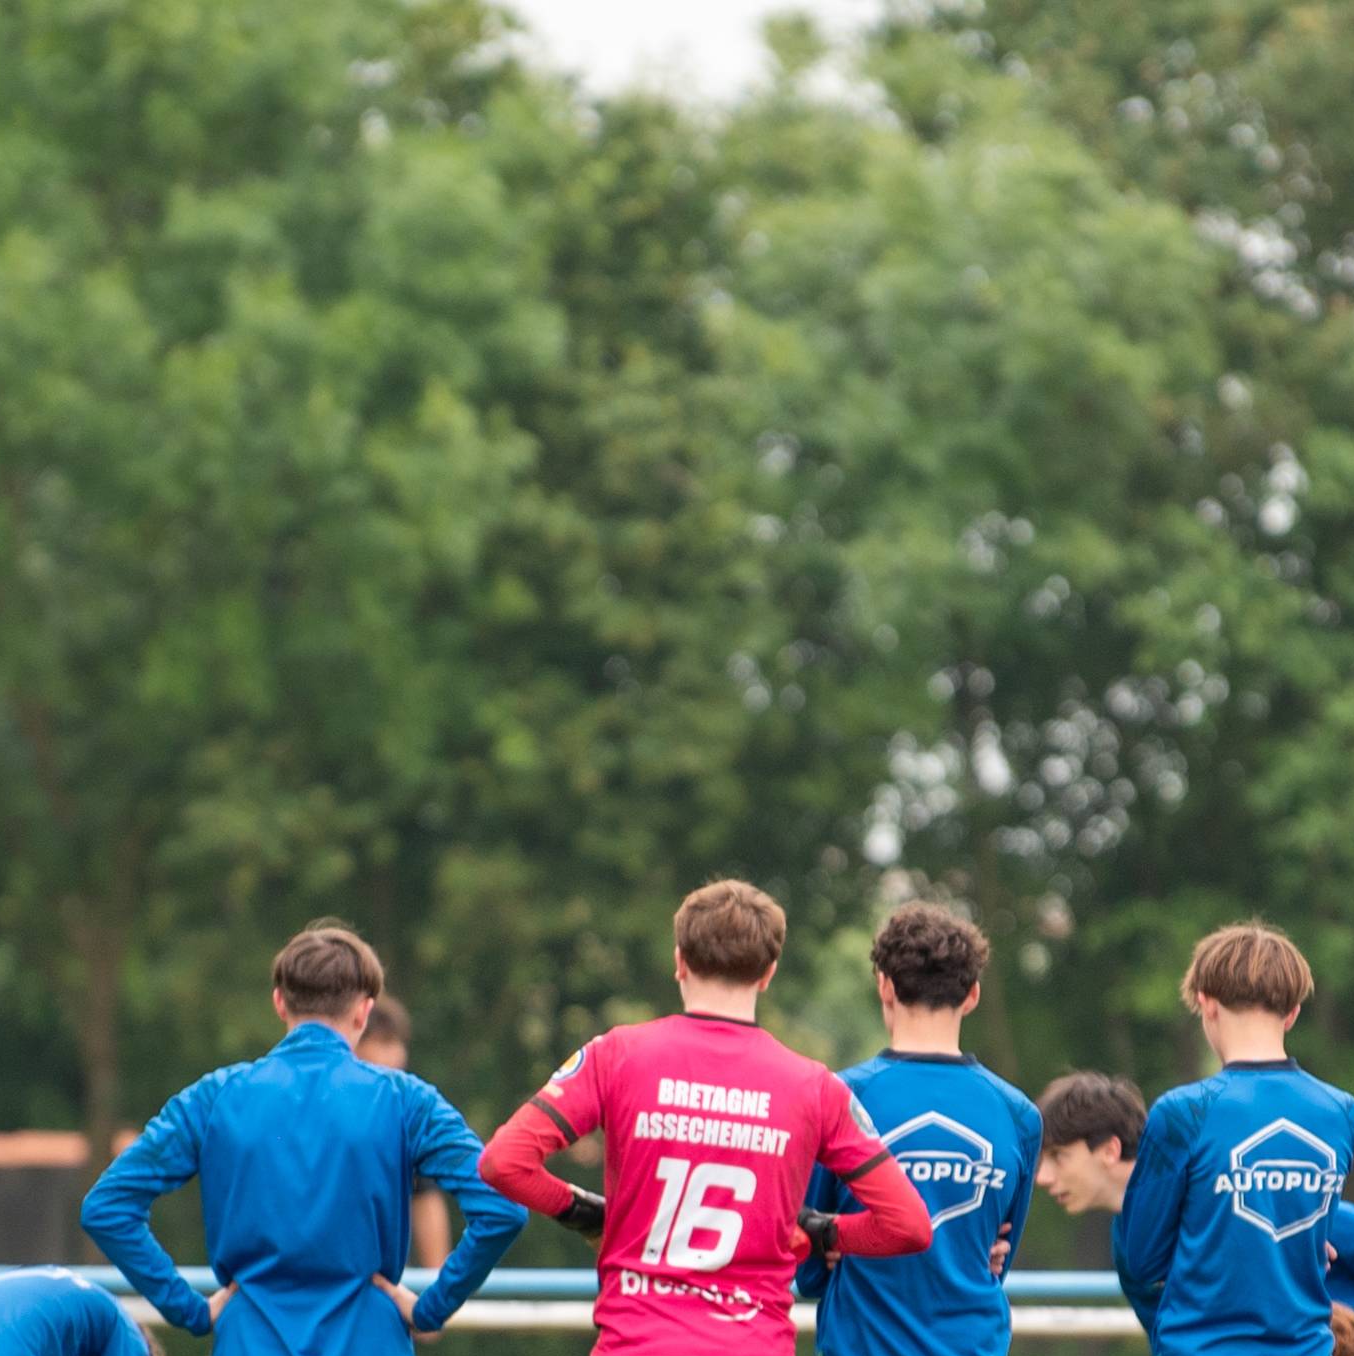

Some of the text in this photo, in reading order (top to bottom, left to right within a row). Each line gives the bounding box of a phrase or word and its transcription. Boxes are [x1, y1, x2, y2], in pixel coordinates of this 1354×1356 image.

[658, 1077, 771, 1119] BRETAGNE
[634, 1111, 791, 1157] ASSECHEMENT
[640, 1156, 758, 1273] 16
